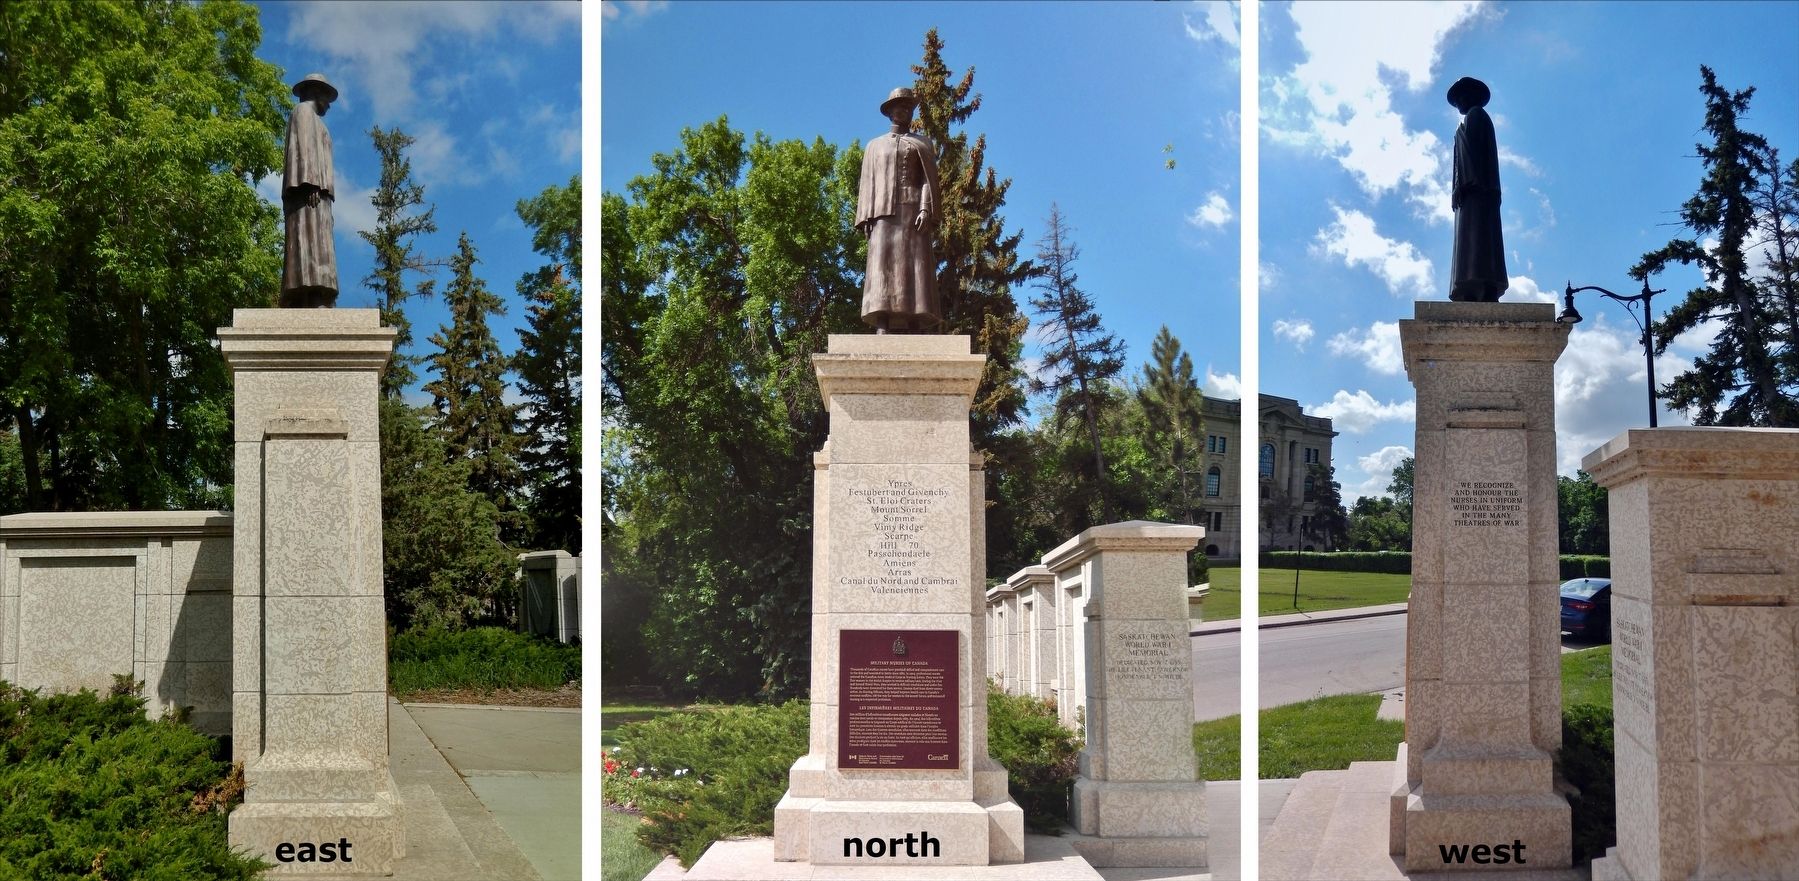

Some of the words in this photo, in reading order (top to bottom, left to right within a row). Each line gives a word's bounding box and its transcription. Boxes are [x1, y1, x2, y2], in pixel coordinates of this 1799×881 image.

[888, 480, 912, 488] Ypres
[849, 488, 890, 496] Festubert
[890, 488, 906, 496] and
[908, 488, 949, 498] Givenchy
[866, 497, 878, 505] St.
[880, 497, 898, 505] Eloi
[900, 497, 932, 505] Craters
[874, 523, 897, 532] Vimy
[899, 523, 924, 532] Ridge
[884, 532, 914, 541] Scarpe
[868, 550, 930, 558] Passchendaele
[887, 568, 912, 576] Arras
[840, 577, 866, 585] Canal
[867, 577, 879, 585] du
[880, 577, 902, 585] Nord
[903, 577, 919, 585] and
[921, 577, 958, 585] Cambrai
[871, 586, 929, 594] Valenciennes
